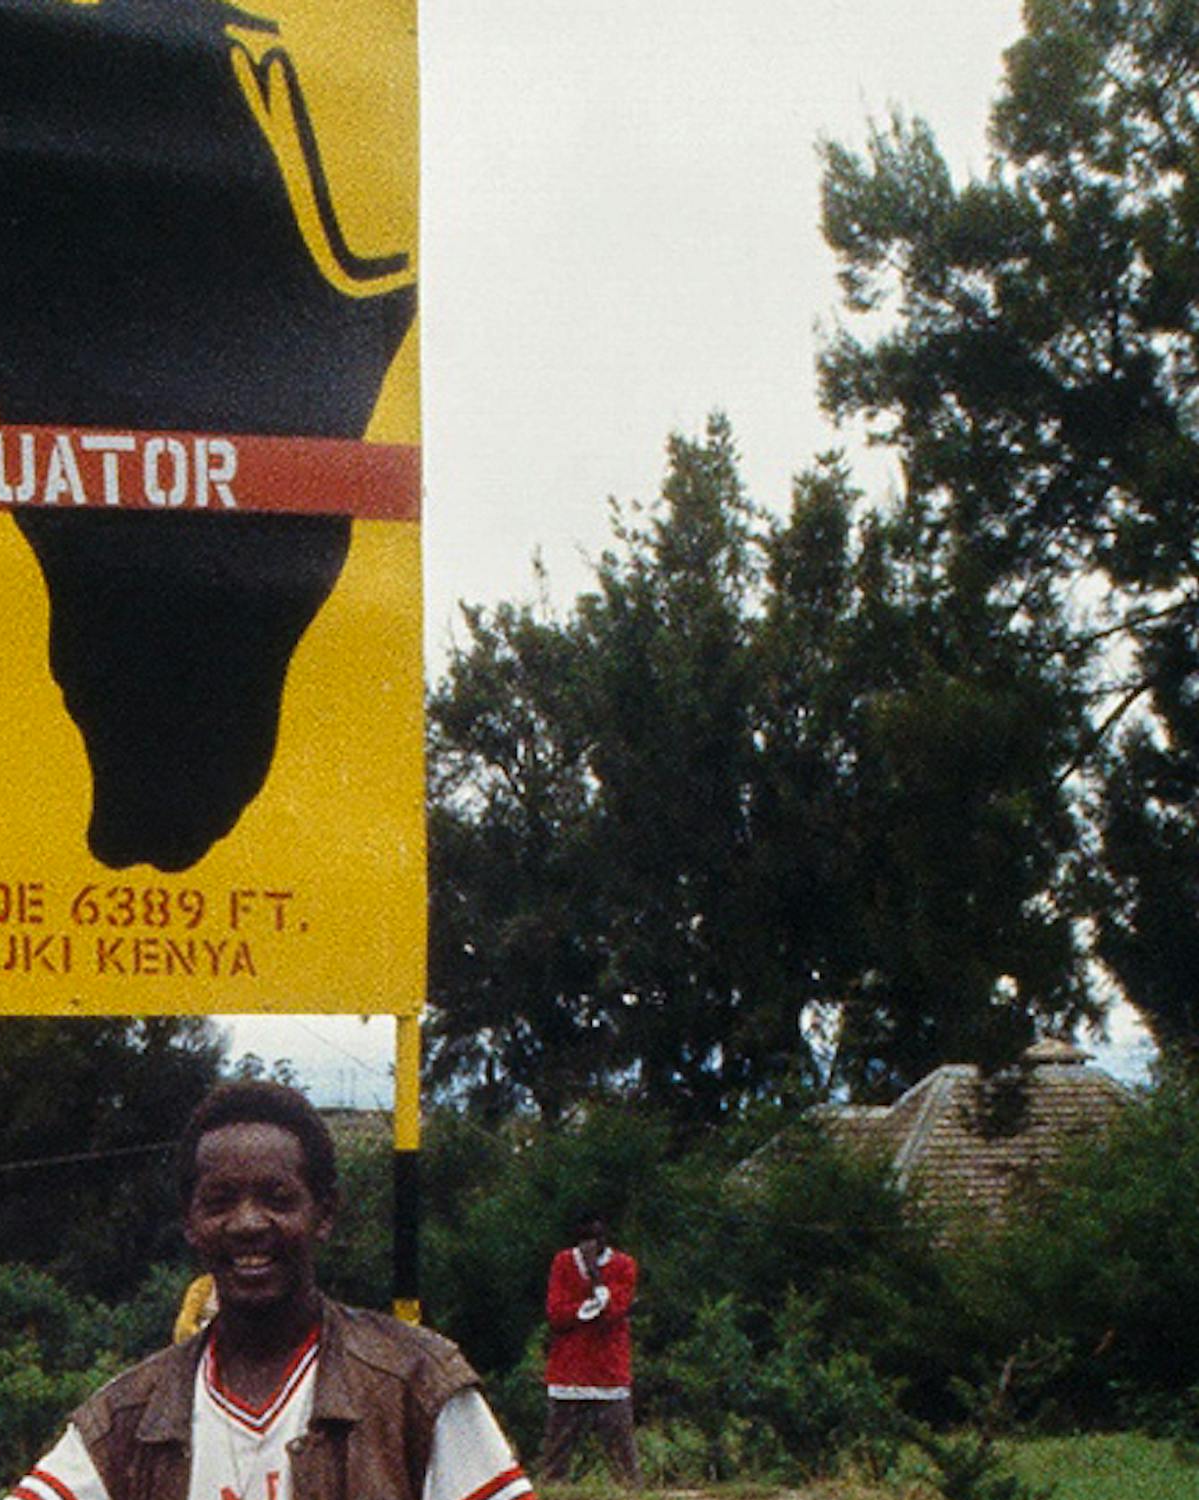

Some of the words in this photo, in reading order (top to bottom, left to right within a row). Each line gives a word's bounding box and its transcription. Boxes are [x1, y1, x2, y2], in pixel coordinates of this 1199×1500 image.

[71, 884, 204, 930] 6389
[229, 890, 308, 932] FT.
[97, 937, 256, 976] KENYA
